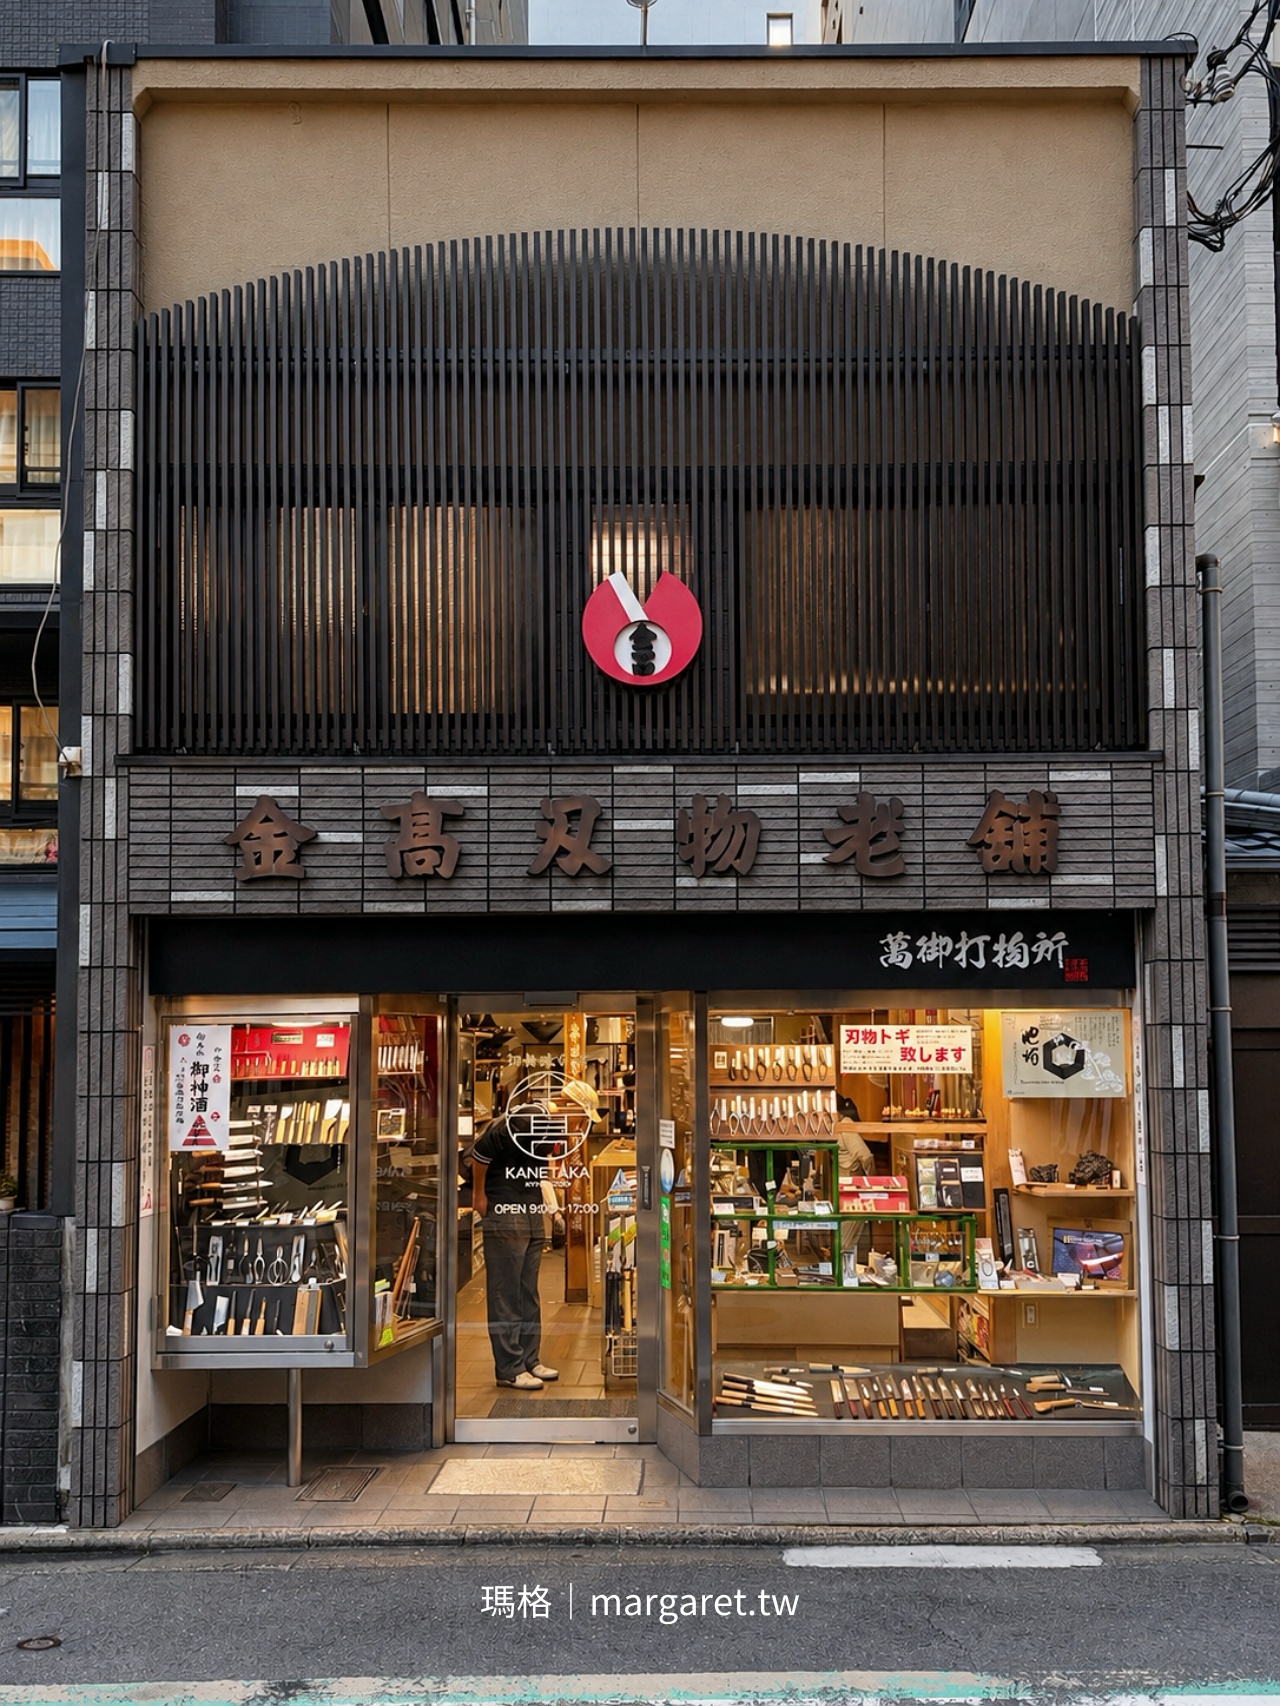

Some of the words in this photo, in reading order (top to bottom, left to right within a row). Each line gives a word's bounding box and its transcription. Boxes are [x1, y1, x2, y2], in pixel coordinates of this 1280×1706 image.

[845, 1029, 911, 1045] 刃物トギ
[900, 1046, 966, 1063] 致します
[190, 1061, 209, 1113] 御神酒
[505, 1166, 590, 1179] KANETAKA
[494, 1203, 526, 1214] OPEN
